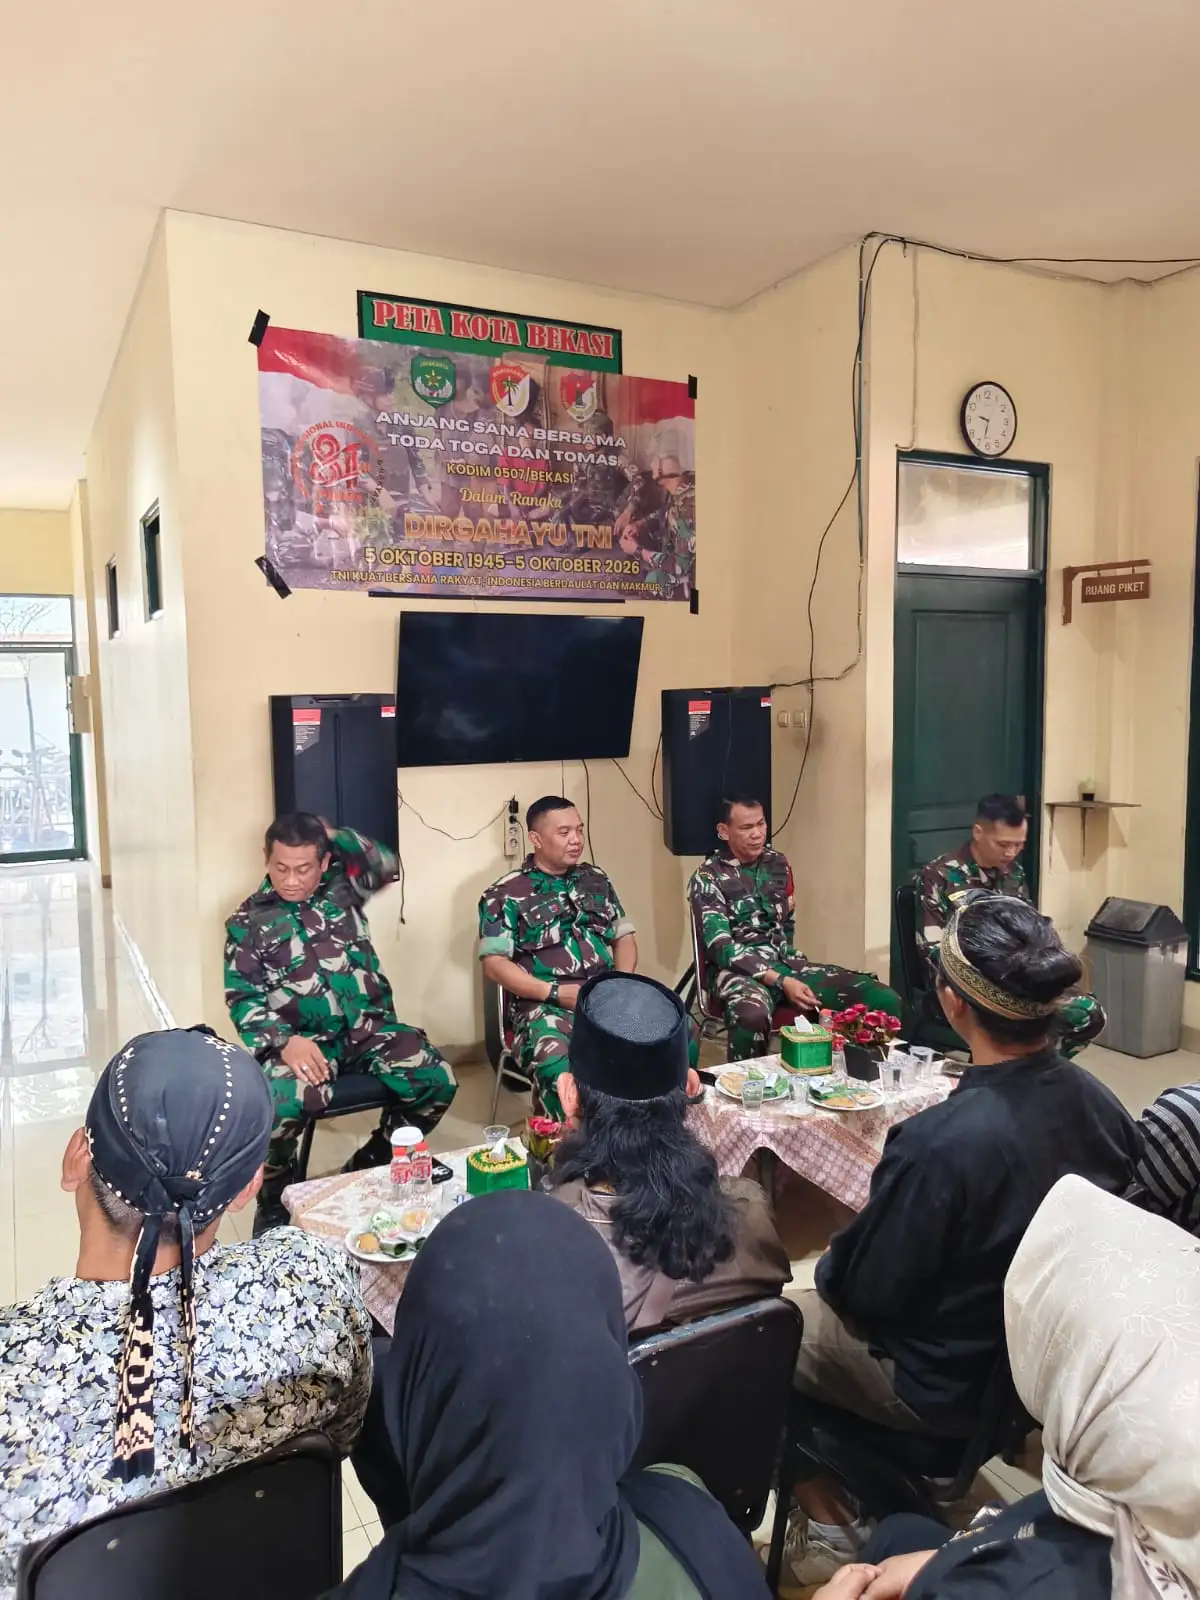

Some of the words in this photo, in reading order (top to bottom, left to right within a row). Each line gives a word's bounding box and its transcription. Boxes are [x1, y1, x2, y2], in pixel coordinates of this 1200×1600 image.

[372, 299, 445, 335] PETA
[450, 311, 521, 346] KOTA
[526, 322, 614, 359] BEKASI
[375, 411, 470, 432] ANJANG
[472, 422, 531, 438] SANA
[533, 428, 627, 449] BERSAMA
[387, 433, 445, 451] TODA
[449, 439, 504, 456] TOGA
[507, 446, 550, 461] DAN
[553, 450, 619, 467] TOMAS
[446, 462, 491, 477] KODIM
[493, 466, 574, 485] 0507/BEKASI
[459, 487, 506, 505] Dalam
[510, 491, 563, 510] Rangka
[404, 512, 567, 546] DIRGAHAYU
[571, 524, 613, 549] TNI
[364, 547, 377, 564] 5
[380, 549, 463, 568] OKTOBER
[529, 556, 602, 574] OKTOBER
[605, 559, 640, 575] 2026
[331, 570, 350, 581] TNI
[352, 571, 384, 583] KUAT
[385, 573, 438, 585] BERSAMA
[487, 577, 542, 588] INDONESIA
[543, 579, 598, 590] BERDAULAT
[599, 581, 619, 590] DAN
[1085, 583, 1117, 596] RUANG
[1118, 581, 1145, 593] PIKET
